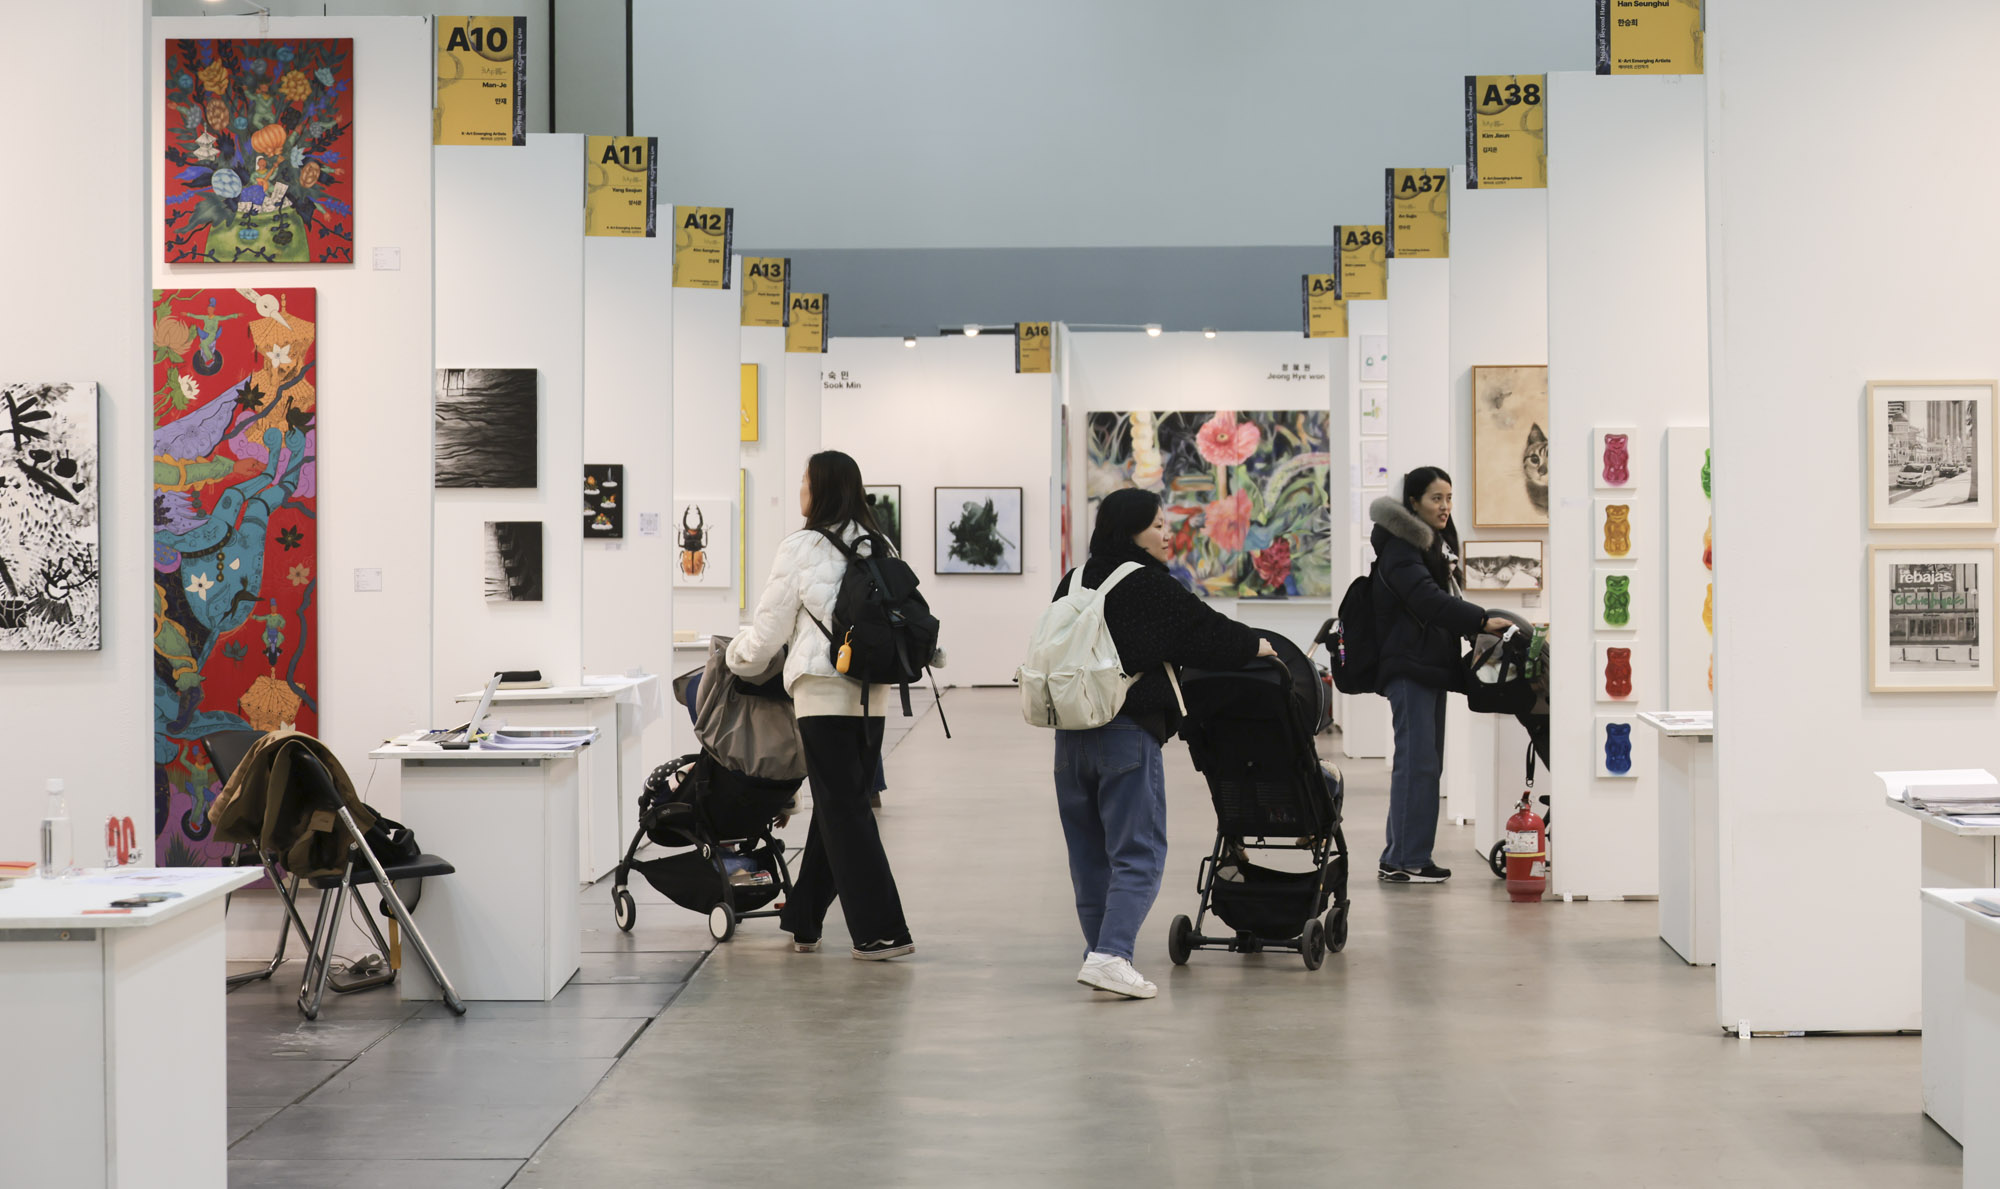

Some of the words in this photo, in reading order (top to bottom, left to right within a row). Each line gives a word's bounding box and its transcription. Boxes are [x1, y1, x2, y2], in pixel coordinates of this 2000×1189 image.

[1633, 0, 1669, 8] Seunghui
[446, 27, 508, 52] A10
[1482, 83, 1541, 106] A38
[601, 145, 642, 165] A11
[1401, 175, 1445, 193] A37
[684, 213, 722, 231] A12
[1345, 231, 1384, 246] A36
[749, 263, 781, 277] A13
[1312, 279, 1335, 292] A3
[792, 298, 820, 310] A14
[1025, 326, 1049, 336] A16
[1267, 372, 1291, 381] Jeong
[1292, 373, 1306, 381] Hye
[823, 381, 843, 389] Sook
[846, 381, 861, 389] Min
[1899, 570, 1954, 585] rebajas
